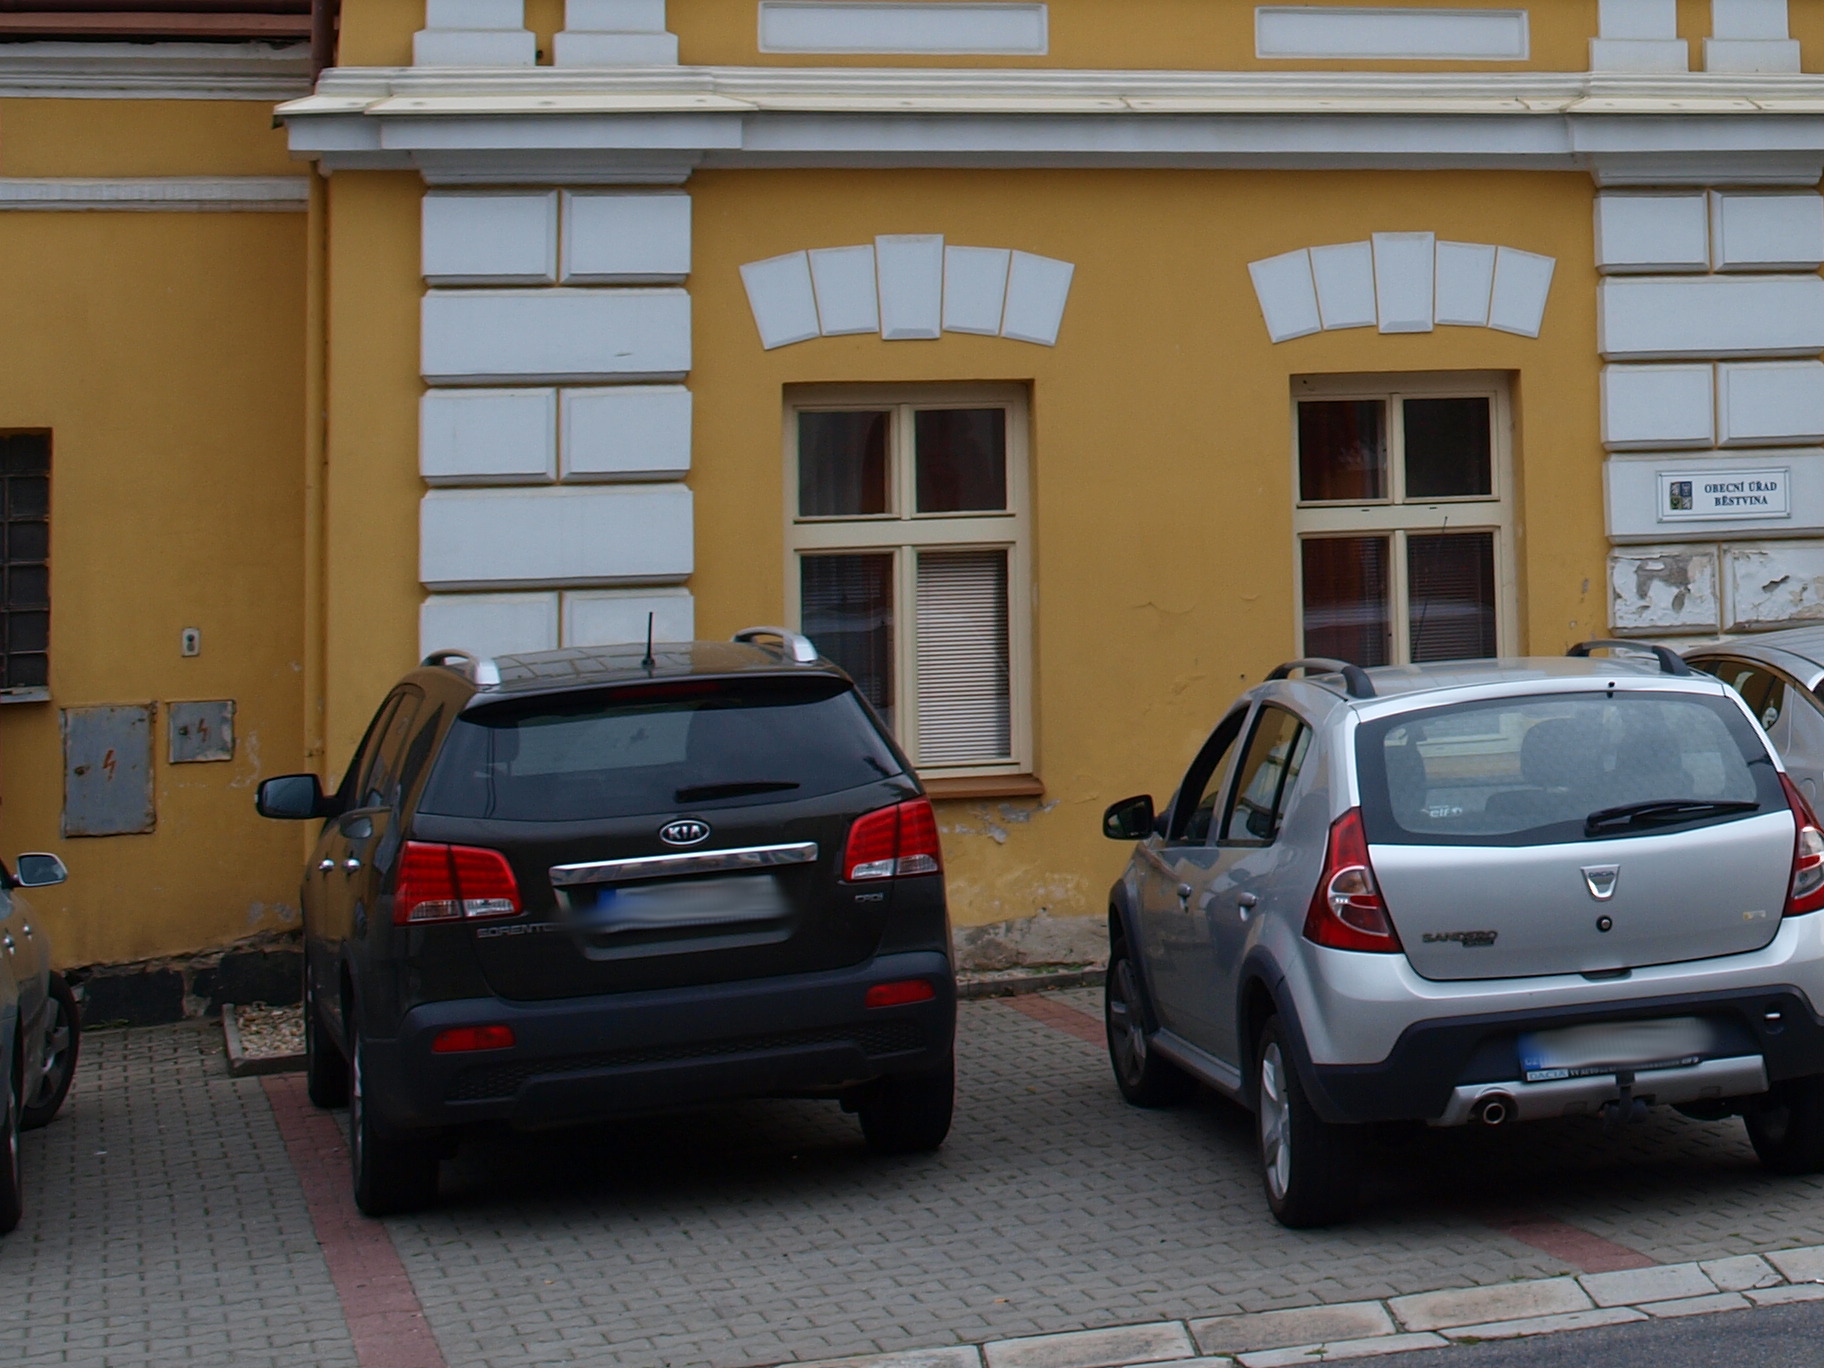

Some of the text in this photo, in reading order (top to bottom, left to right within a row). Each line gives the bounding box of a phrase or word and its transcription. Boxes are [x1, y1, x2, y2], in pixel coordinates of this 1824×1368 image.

[1704, 481, 1744, 493] OBECNÍ
[1714, 495, 1768, 507] BĚSTVINA
[667, 825, 702, 840] KIA
[1528, 1070, 1567, 1080] DACIA
